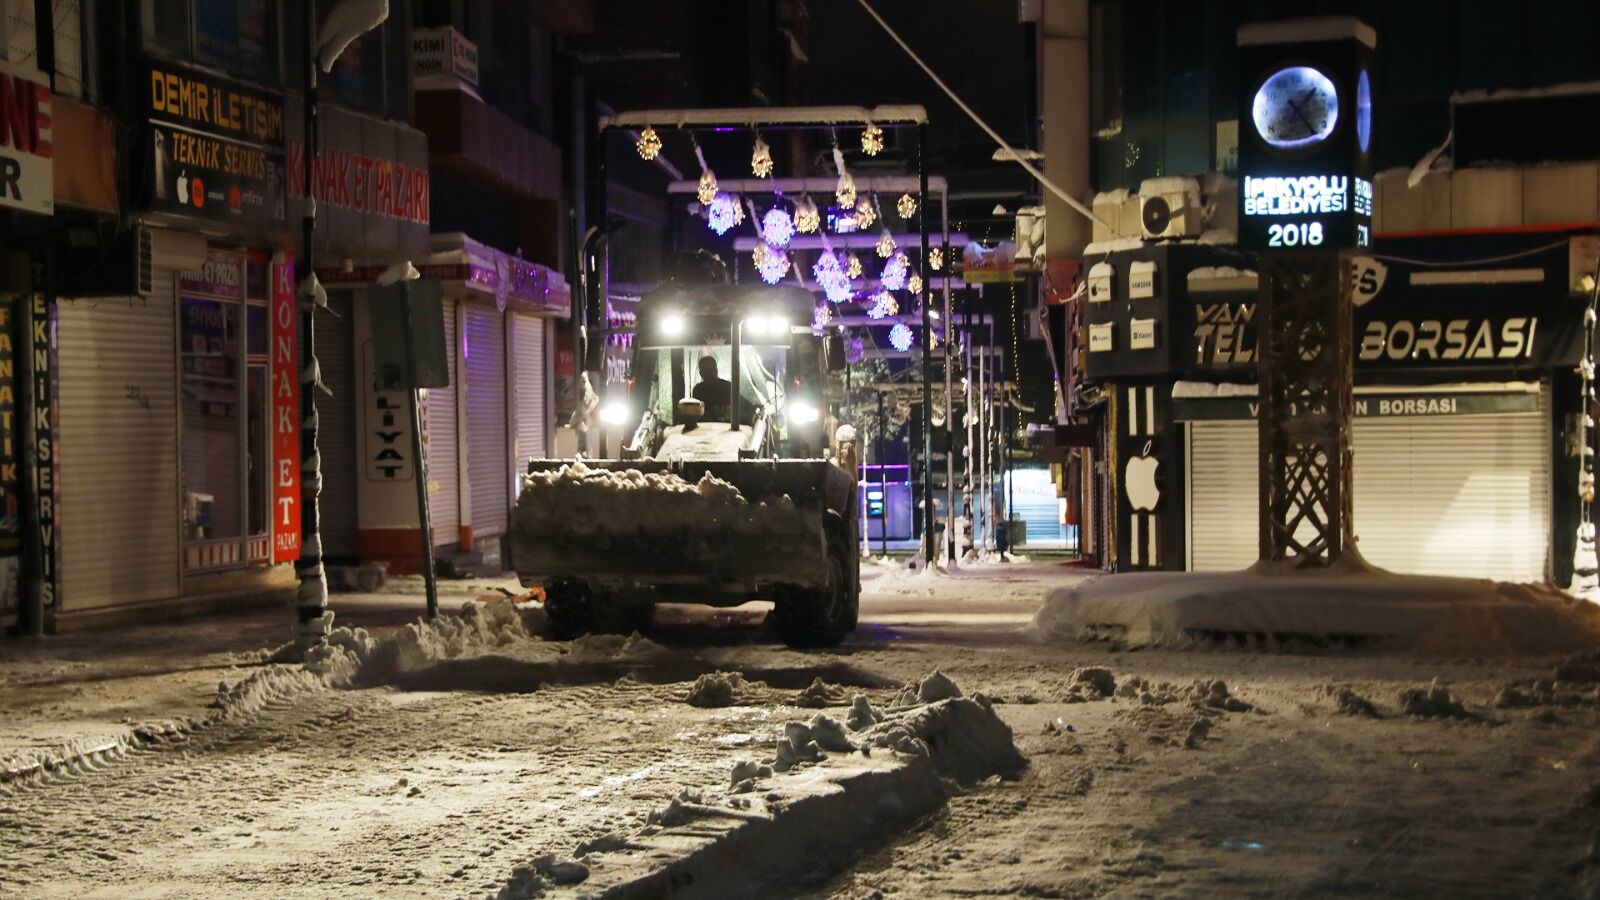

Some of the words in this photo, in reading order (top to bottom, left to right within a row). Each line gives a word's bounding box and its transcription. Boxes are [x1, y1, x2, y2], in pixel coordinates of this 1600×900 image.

[287, 139, 351, 209] KNAK
[354, 154, 373, 214] ET
[375, 158, 430, 226] PAZARI
[1244, 174, 1348, 197] İPEKYOLU
[1244, 194, 1348, 216] BELEDİYESİ
[1267, 221, 1324, 248] 2018
[1195, 303, 1257, 324] VAN
[278, 264, 293, 433] KONAK
[1359, 316, 1538, 361] BORSASI
[1380, 397, 1457, 415] BORSASI
[278, 458, 294, 526] ET
